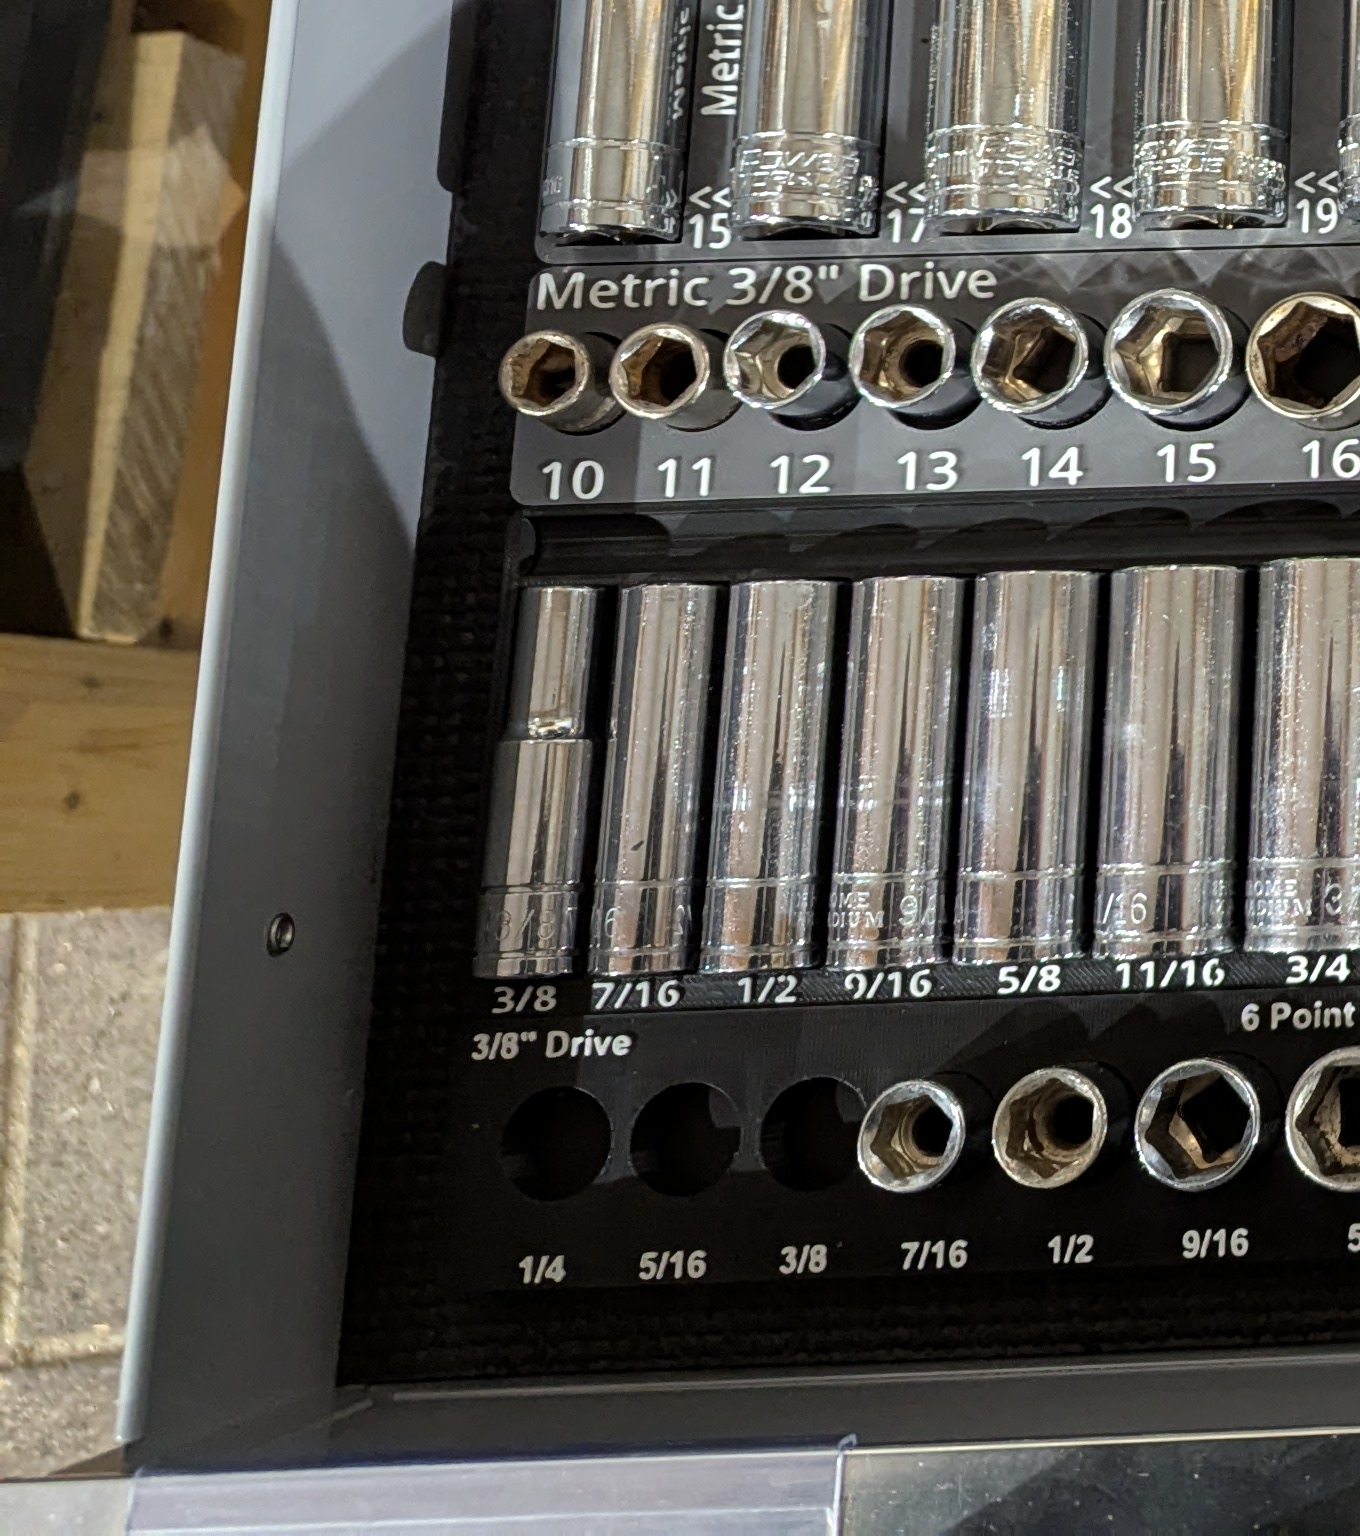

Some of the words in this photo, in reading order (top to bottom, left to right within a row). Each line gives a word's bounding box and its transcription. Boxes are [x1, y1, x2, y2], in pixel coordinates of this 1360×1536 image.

[699, 4, 745, 116] Metric
[690, 213, 730, 249] 15
[888, 209, 926, 244] 17
[1097, 204, 1131, 240] 18
[1297, 198, 1337, 234] 19
[537, 270, 710, 309] Metric
[726, 264, 838, 306] 3/8"
[859, 263, 996, 300] Drive
[543, 461, 604, 500] 10
[658, 458, 711, 497] 11
[770, 455, 830, 494] 12
[898, 451, 957, 490] 13
[1022, 447, 1083, 486] 14
[1157, 443, 1216, 482] 15
[1302, 439, 1360, 478] 16
[492, 986, 556, 1013] 3/8
[593, 980, 681, 1009] 7/16
[738, 974, 798, 1003] 1/2
[844, 969, 932, 999] 9/16
[998, 963, 1062, 993] 5/8
[1115, 959, 1226, 988] 11/16
[1285, 954, 1351, 983] 3/4
[1241, 1003, 1259, 1031] 6
[1271, 1000, 1355, 1030] Point
[472, 1031, 537, 1060] 3/8"
[546, 1029, 632, 1057] Drive
[519, 1255, 566, 1284] 1/4
[639, 1250, 706, 1280] 5/16
[779, 1245, 827, 1274] 3/8
[901, 1240, 967, 1270] 7/16
[1048, 1234, 1093, 1263] 1/2
[1182, 1228, 1248, 1258] 9/16
